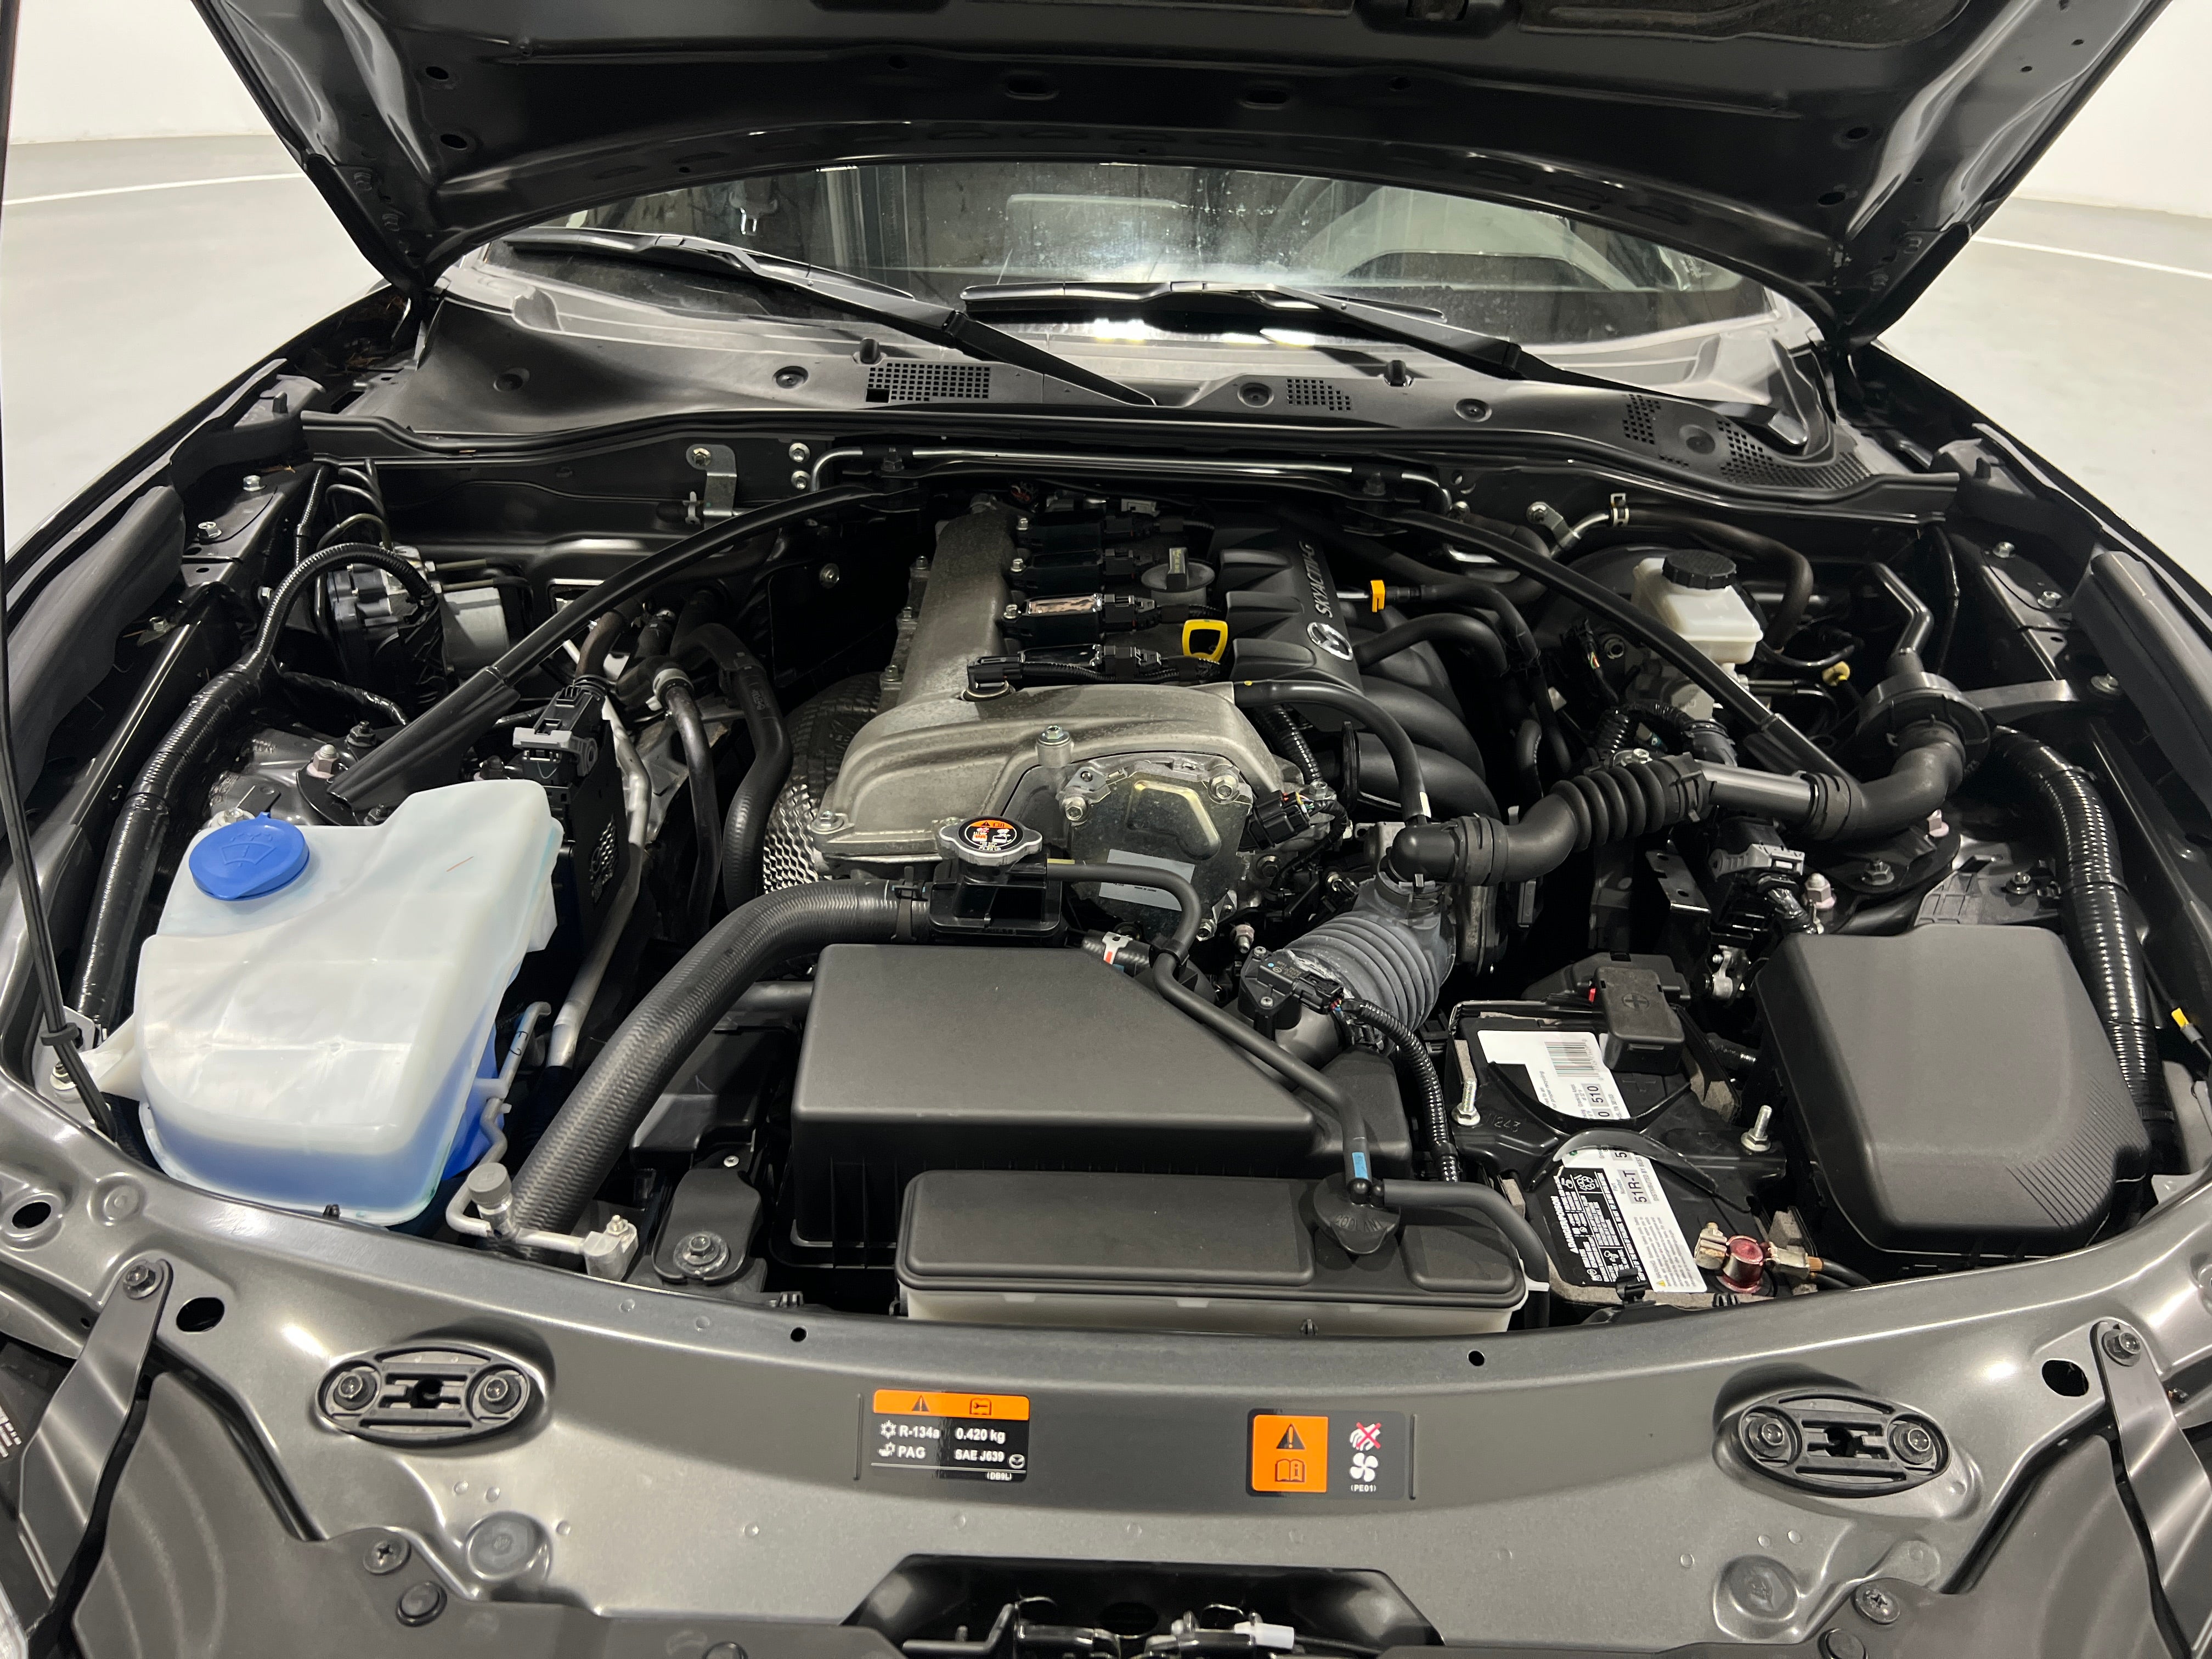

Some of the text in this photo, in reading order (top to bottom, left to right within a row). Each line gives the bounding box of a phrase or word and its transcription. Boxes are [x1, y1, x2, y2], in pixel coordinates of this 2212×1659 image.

[1299, 540, 1333, 618] SKYACTIV-G
[1587, 1086, 1604, 1103] 510
[1635, 1157, 1645, 1167] BEST
[1622, 1170, 1647, 1203] 51R-T
[1643, 1174, 1660, 1201] DISTRIBUTED
[899, 1425, 1006, 1444] R-134a 0.420 kg
[896, 1446, 1005, 1463] PAG SAE J639
[1351, 1484, 1376, 1493] (PE01)
